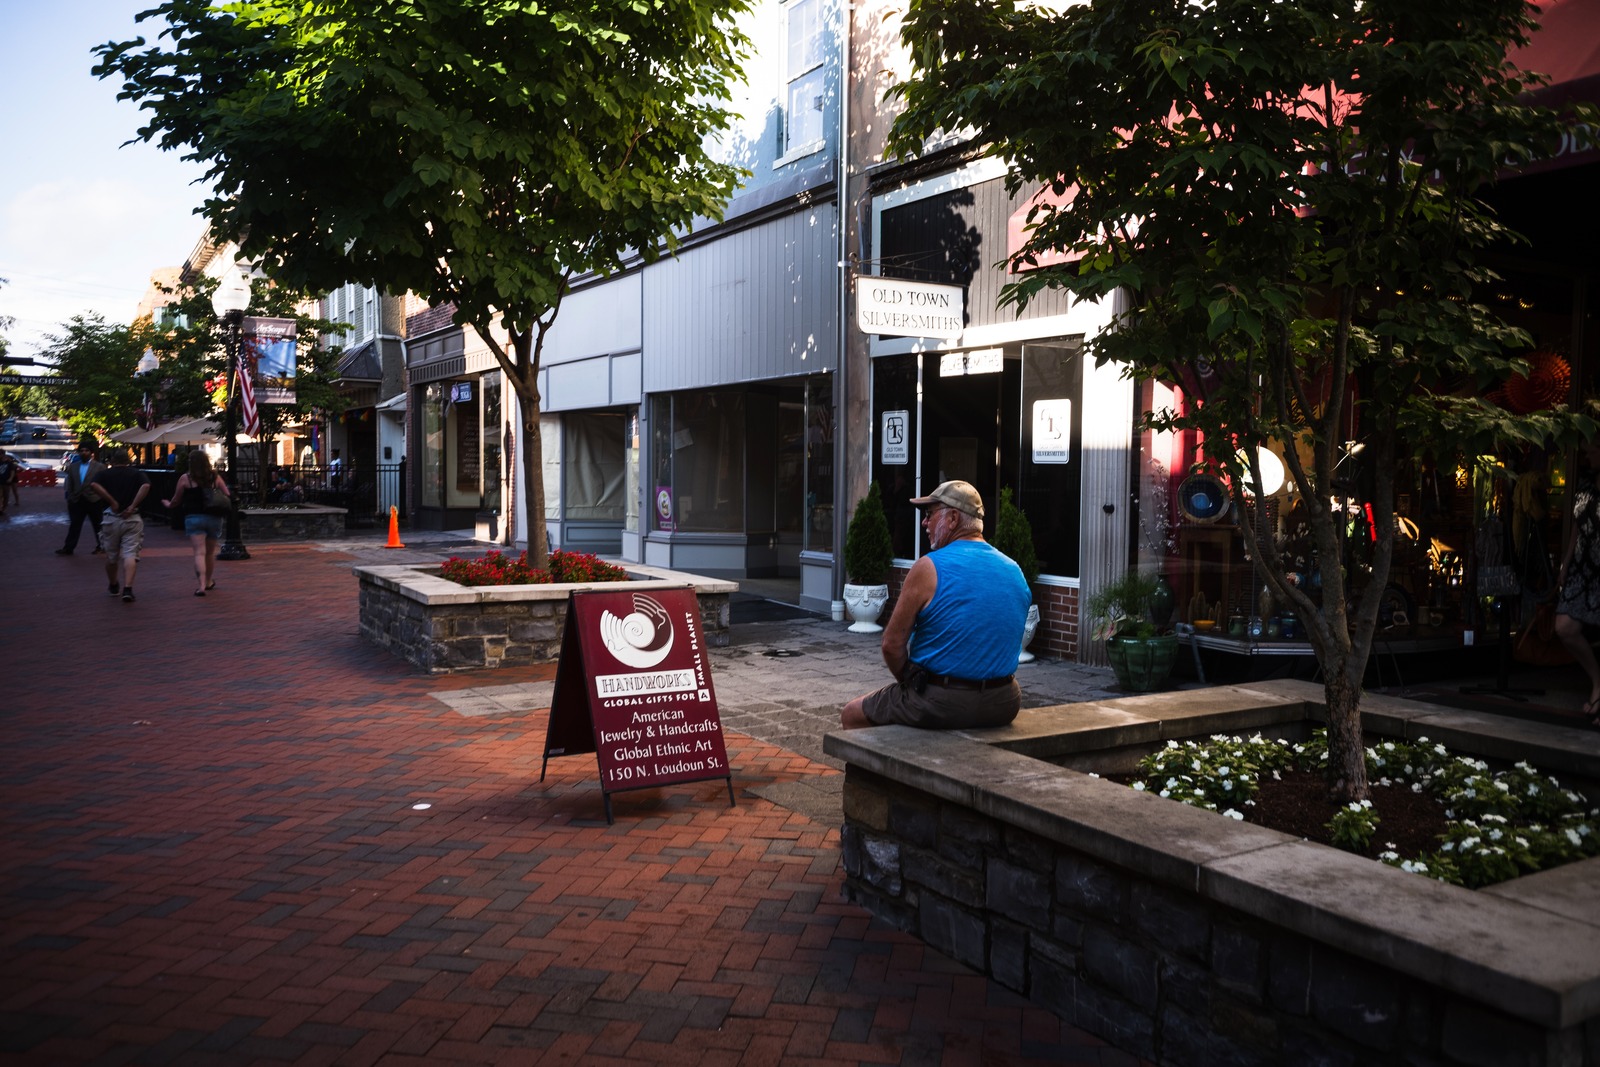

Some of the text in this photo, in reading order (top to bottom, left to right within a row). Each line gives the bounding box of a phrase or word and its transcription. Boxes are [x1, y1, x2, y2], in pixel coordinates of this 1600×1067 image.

[873, 288, 949, 308] OLD TOWN
[863, 310, 960, 330] SILVERSMITHS
[685, 612, 705, 686] SMALL PLANET
[602, 673, 692, 693] HANDWORKS
[604, 697, 643, 708] GLOBAL
[646, 695, 673, 704] GIFTS
[676, 693, 695, 701] FOR
[631, 709, 684, 724] American
[600, 719, 718, 745] Jewelry & Handcrafts
[614, 740, 713, 761] Global Ethnic Art
[609, 757, 723, 781] 150 N. Loudoun St.
